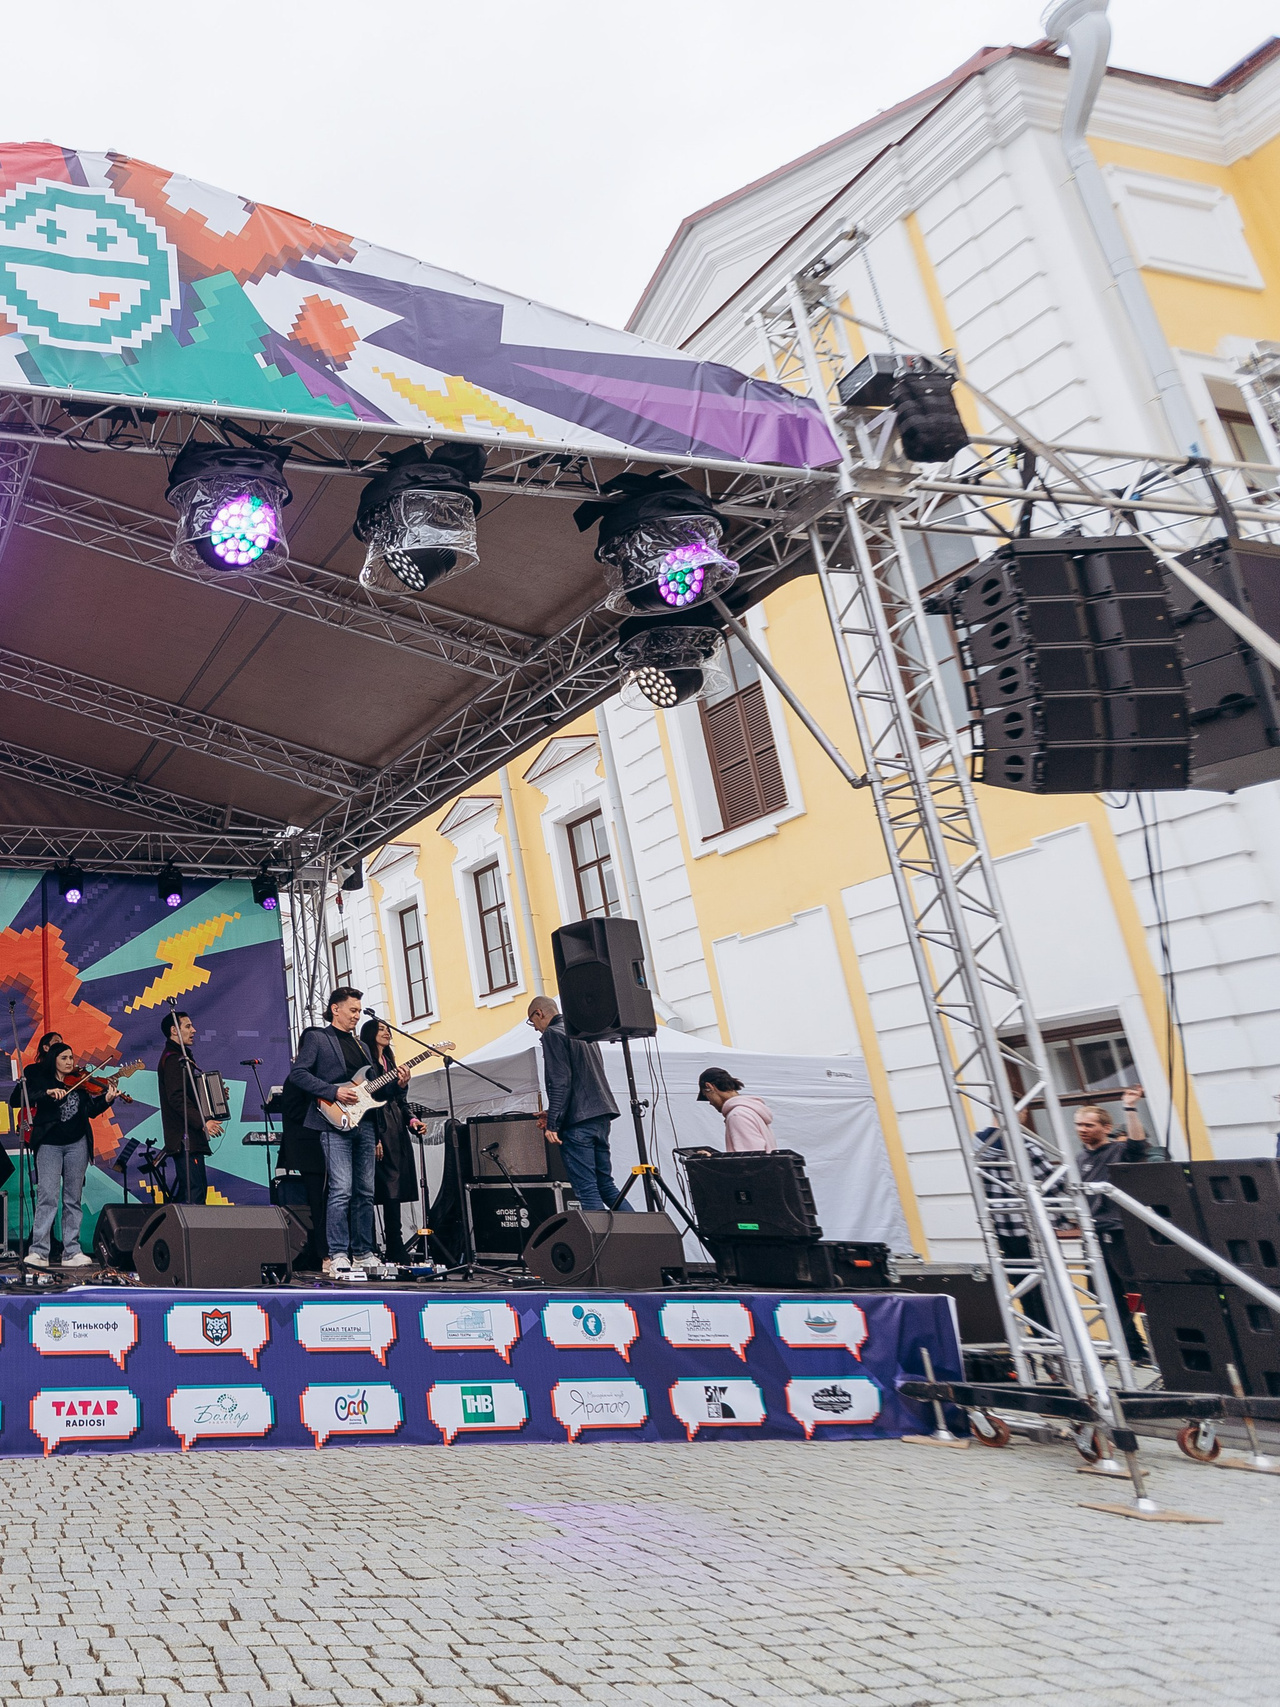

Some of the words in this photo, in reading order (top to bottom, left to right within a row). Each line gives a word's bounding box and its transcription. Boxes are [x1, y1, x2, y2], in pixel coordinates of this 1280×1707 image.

[71, 1320, 119, 1332] Тинькофф
[72, 1331, 89, 1339] Банк
[52, 1400, 119, 1416] TATAR
[570, 1389, 630, 1420] Яратам
[65, 1419, 105, 1427] RADIOSI
[194, 1404, 250, 1428] Болгар
